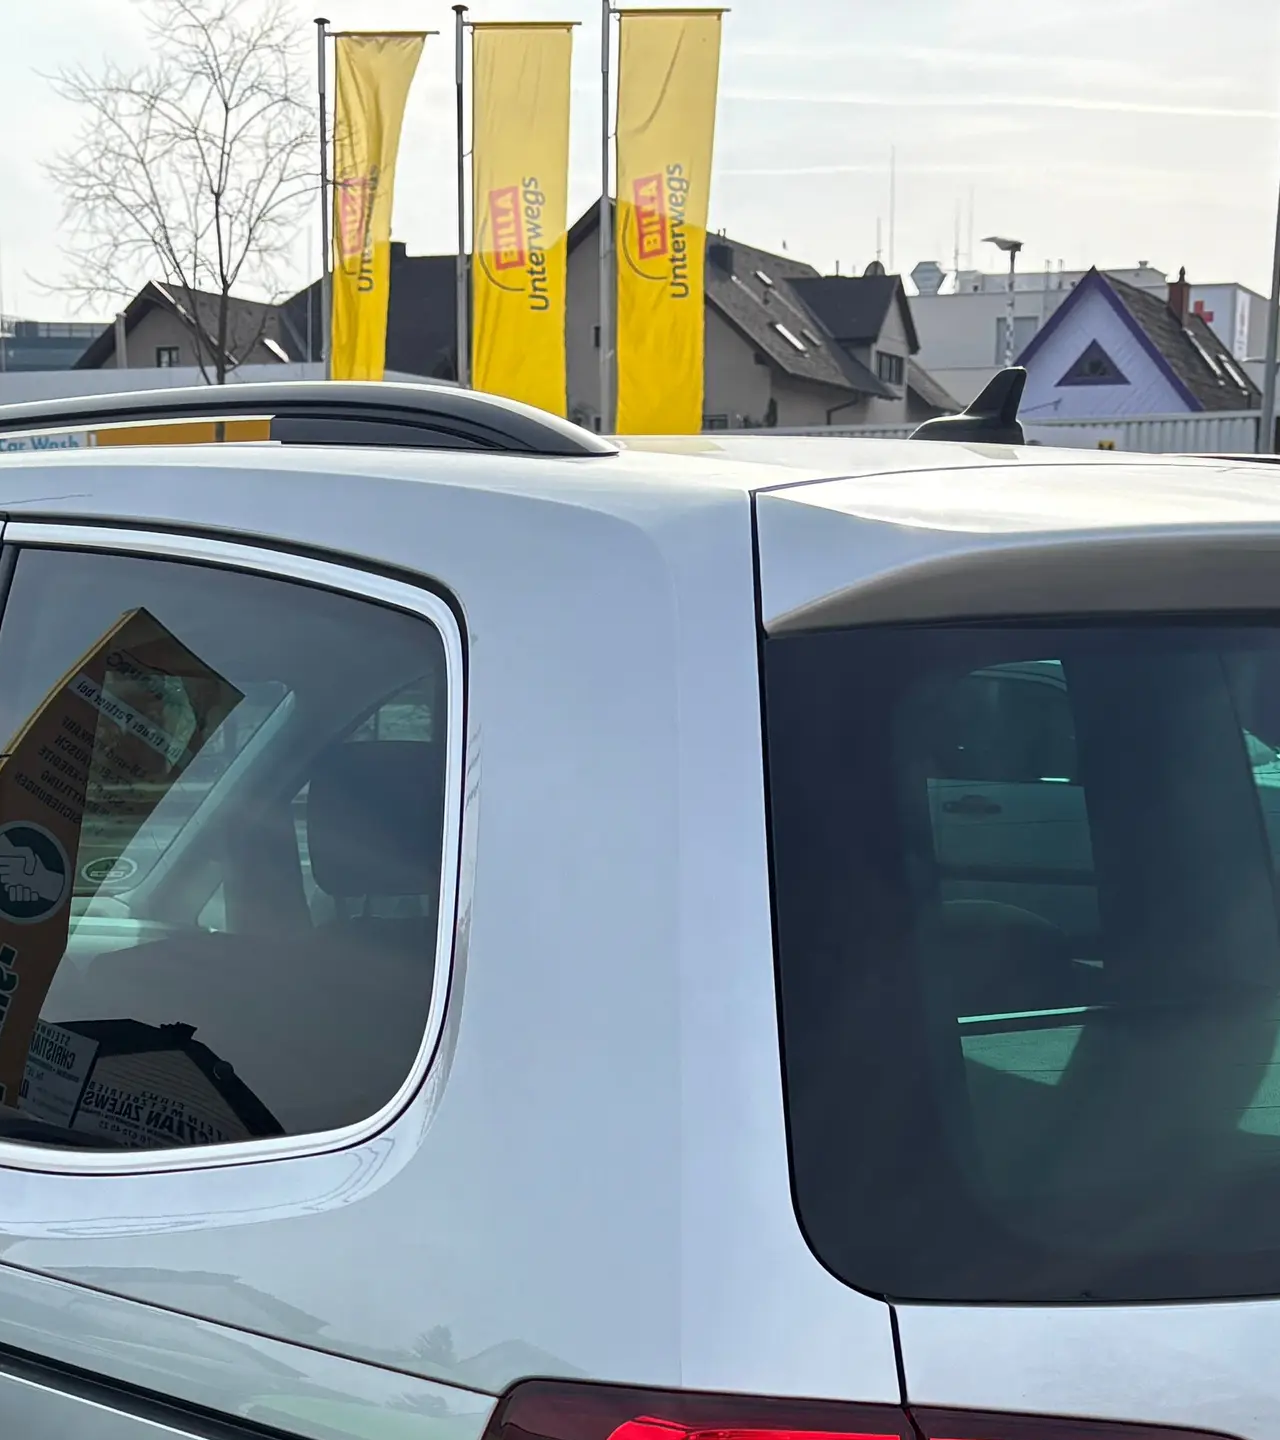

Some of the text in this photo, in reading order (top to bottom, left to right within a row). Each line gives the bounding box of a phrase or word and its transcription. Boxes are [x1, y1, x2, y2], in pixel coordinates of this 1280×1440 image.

[493, 190, 520, 267] BILLA
[521, 176, 550, 312] Unterwegs
[638, 179, 664, 254] BILLA
[666, 163, 690, 299] Unterwegs
[30, 434, 81, 450] Wash
